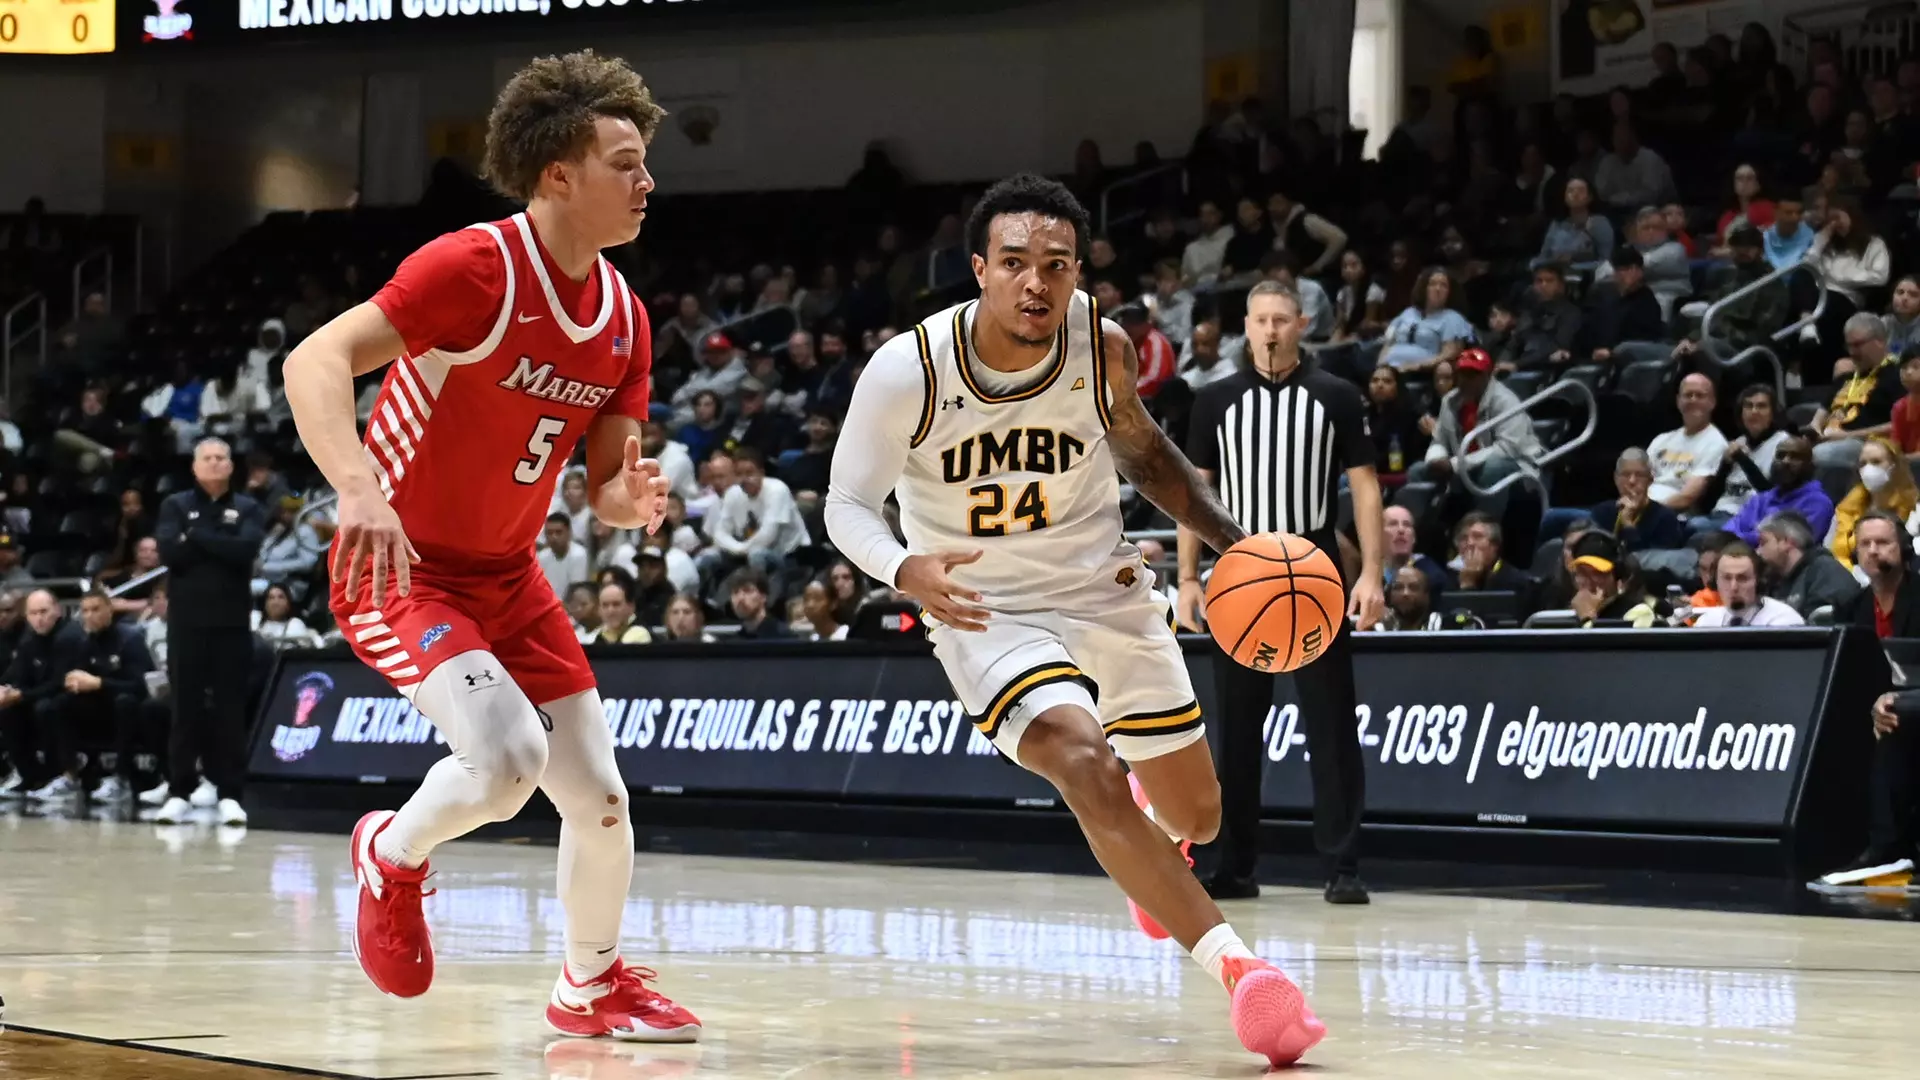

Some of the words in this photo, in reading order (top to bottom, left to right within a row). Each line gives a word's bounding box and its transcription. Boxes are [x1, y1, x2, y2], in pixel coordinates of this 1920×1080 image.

[72, 14, 88, 42] 0
[513, 416, 566, 484] 5
[967, 481, 1053, 537] 24
[661, 698, 795, 752] TEQUILAS
[792, 699, 822, 752] &
[822, 699, 887, 752] THE
[882, 699, 964, 755] BEST
[1497, 705, 1796, 780] elguapomd.com
